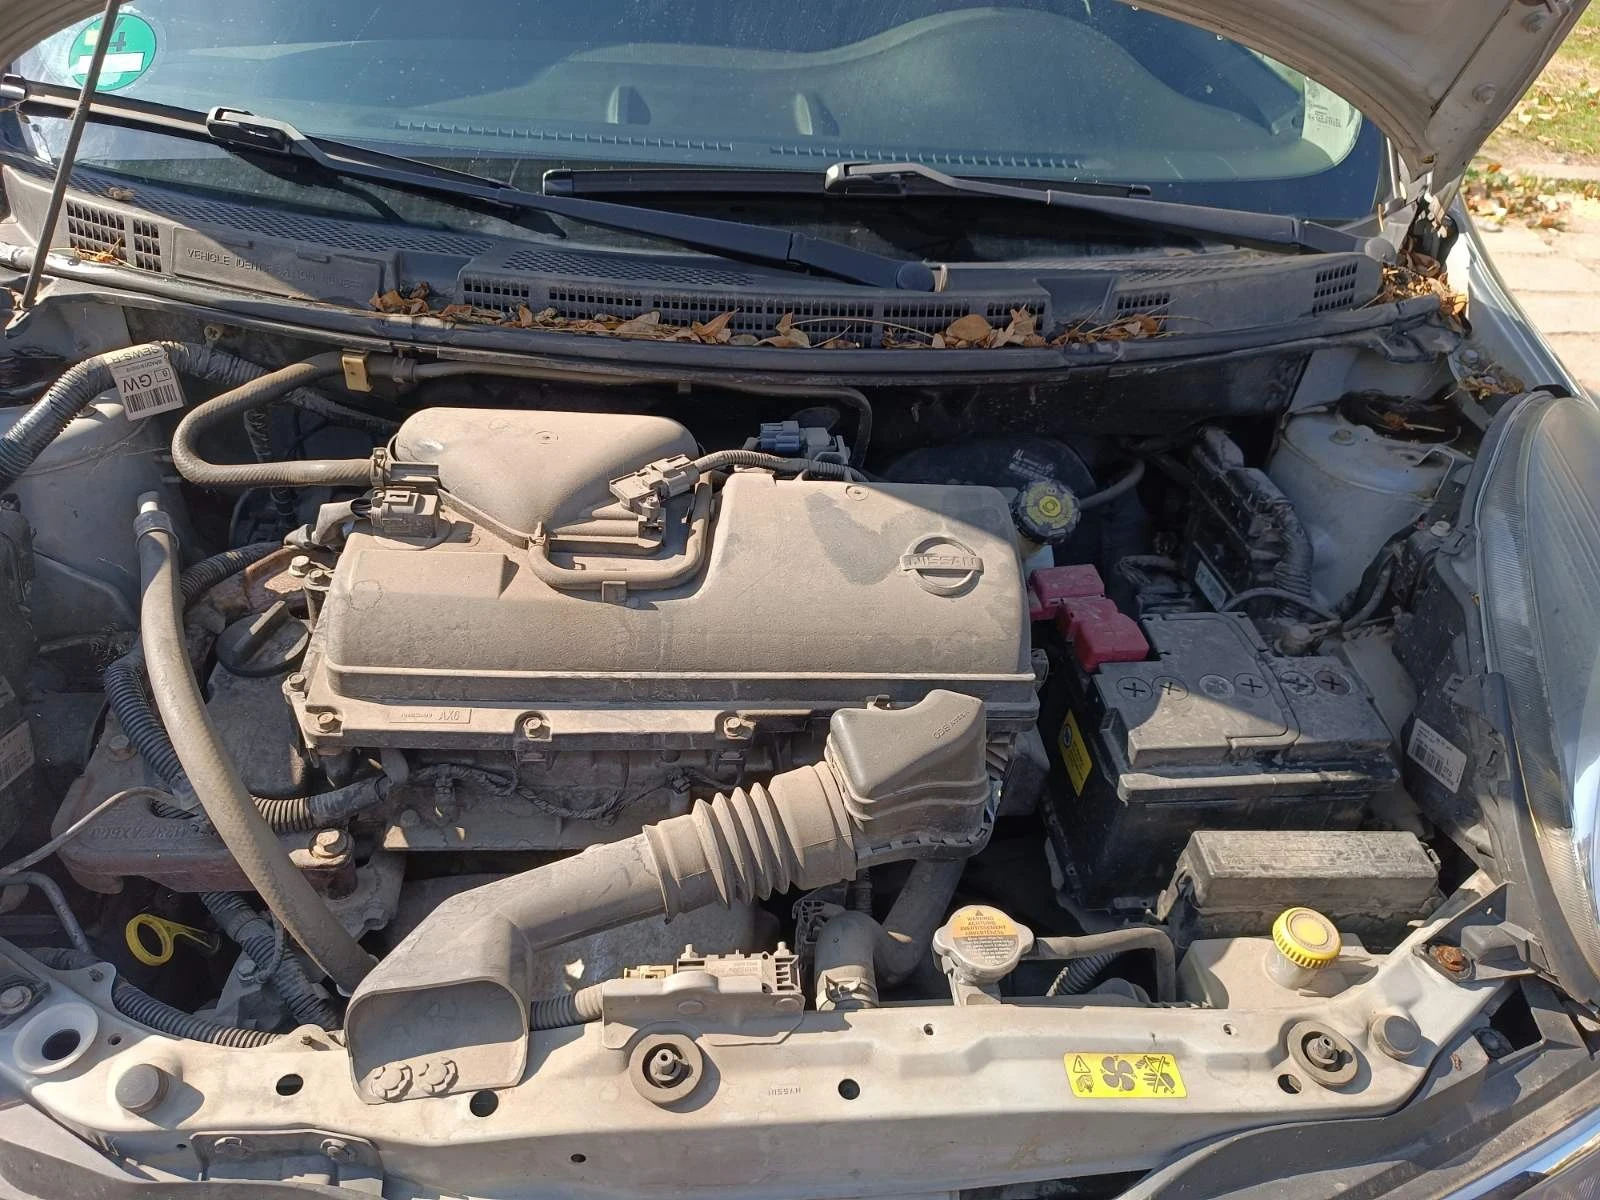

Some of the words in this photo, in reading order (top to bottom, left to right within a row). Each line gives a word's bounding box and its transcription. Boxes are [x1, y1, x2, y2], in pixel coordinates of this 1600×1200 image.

[186, 248, 232, 266] VEHICLE
[123, 373, 152, 393] GW
[907, 555, 977, 568] NISSAN
